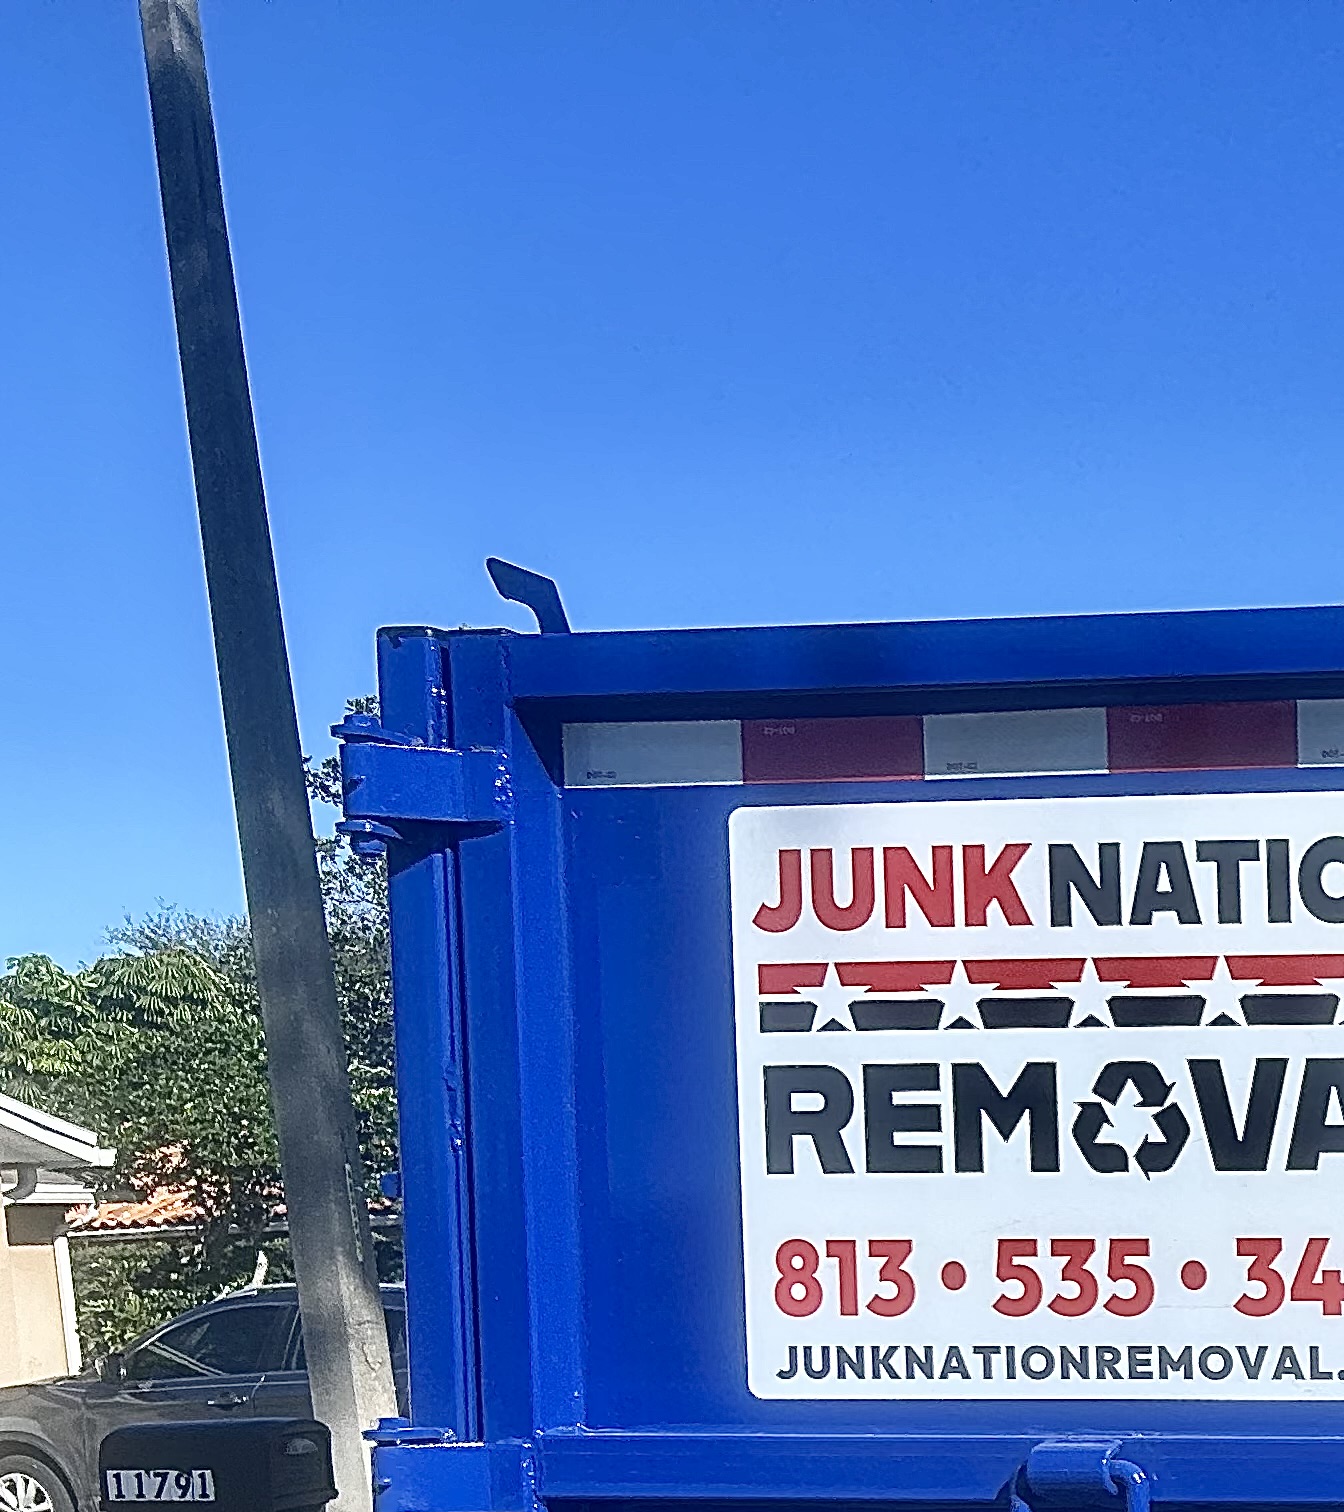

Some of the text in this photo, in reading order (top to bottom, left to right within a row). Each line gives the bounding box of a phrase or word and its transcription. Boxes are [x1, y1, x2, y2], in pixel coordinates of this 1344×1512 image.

[752, 843, 1033, 933] JUNK
[773, 1238, 916, 1317] 813
[992, 1238, 1156, 1317] 535
[112, 1471, 212, 1500] 11791
